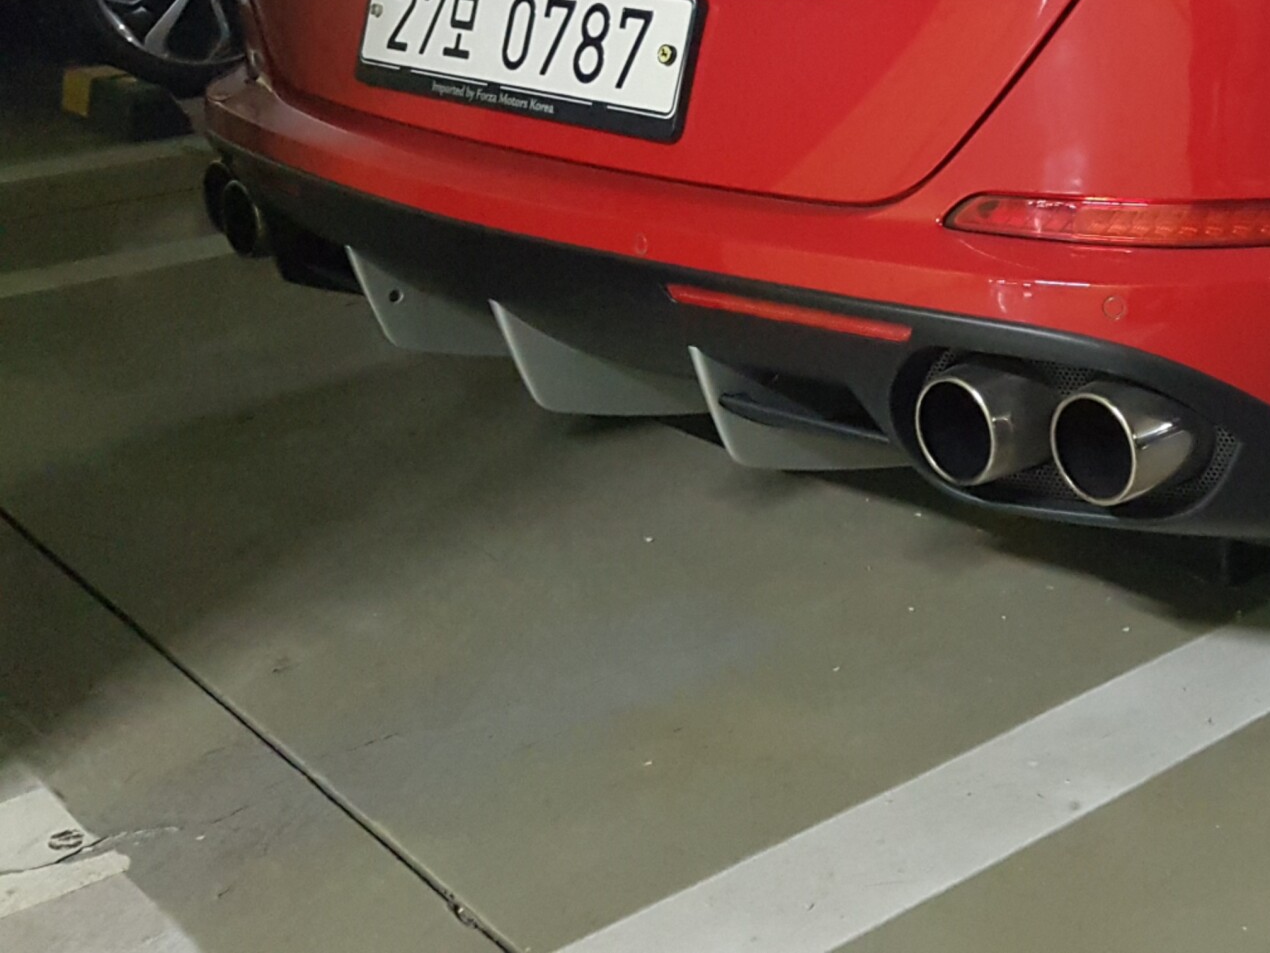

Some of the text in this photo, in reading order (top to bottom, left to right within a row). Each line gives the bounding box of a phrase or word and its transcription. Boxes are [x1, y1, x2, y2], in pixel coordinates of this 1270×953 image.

[432, 80, 554, 114] Imported by Forza Motors Korea
